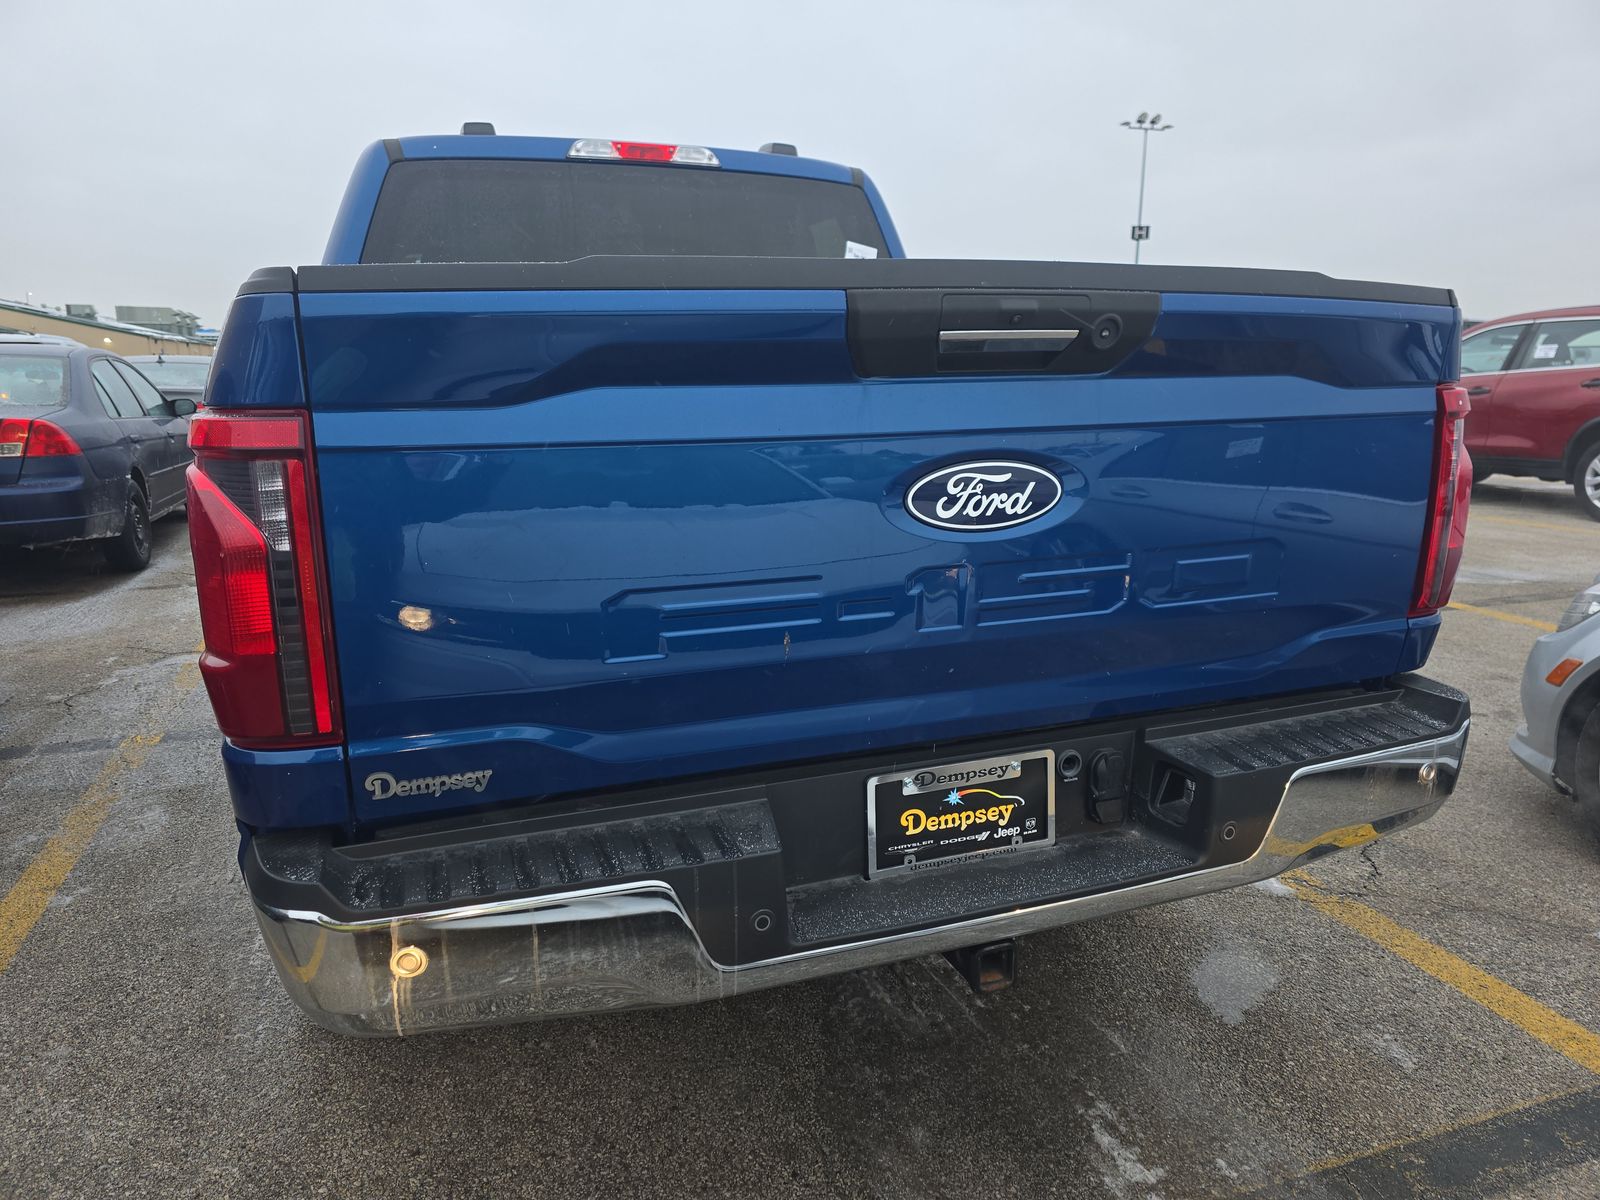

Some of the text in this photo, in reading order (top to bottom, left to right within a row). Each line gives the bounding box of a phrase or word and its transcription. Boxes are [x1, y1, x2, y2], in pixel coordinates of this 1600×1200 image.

[936, 473, 1036, 519] Ford
[365, 769, 493, 800] Dempsey
[915, 764, 1011, 787] Dempsey
[900, 803, 1015, 836] Dempsey
[940, 832, 982, 845] DODGE
[993, 826, 1021, 839] Jeep
[888, 839, 934, 851] CHRYSLER
[910, 846, 1017, 872] dempseyjeep.com
